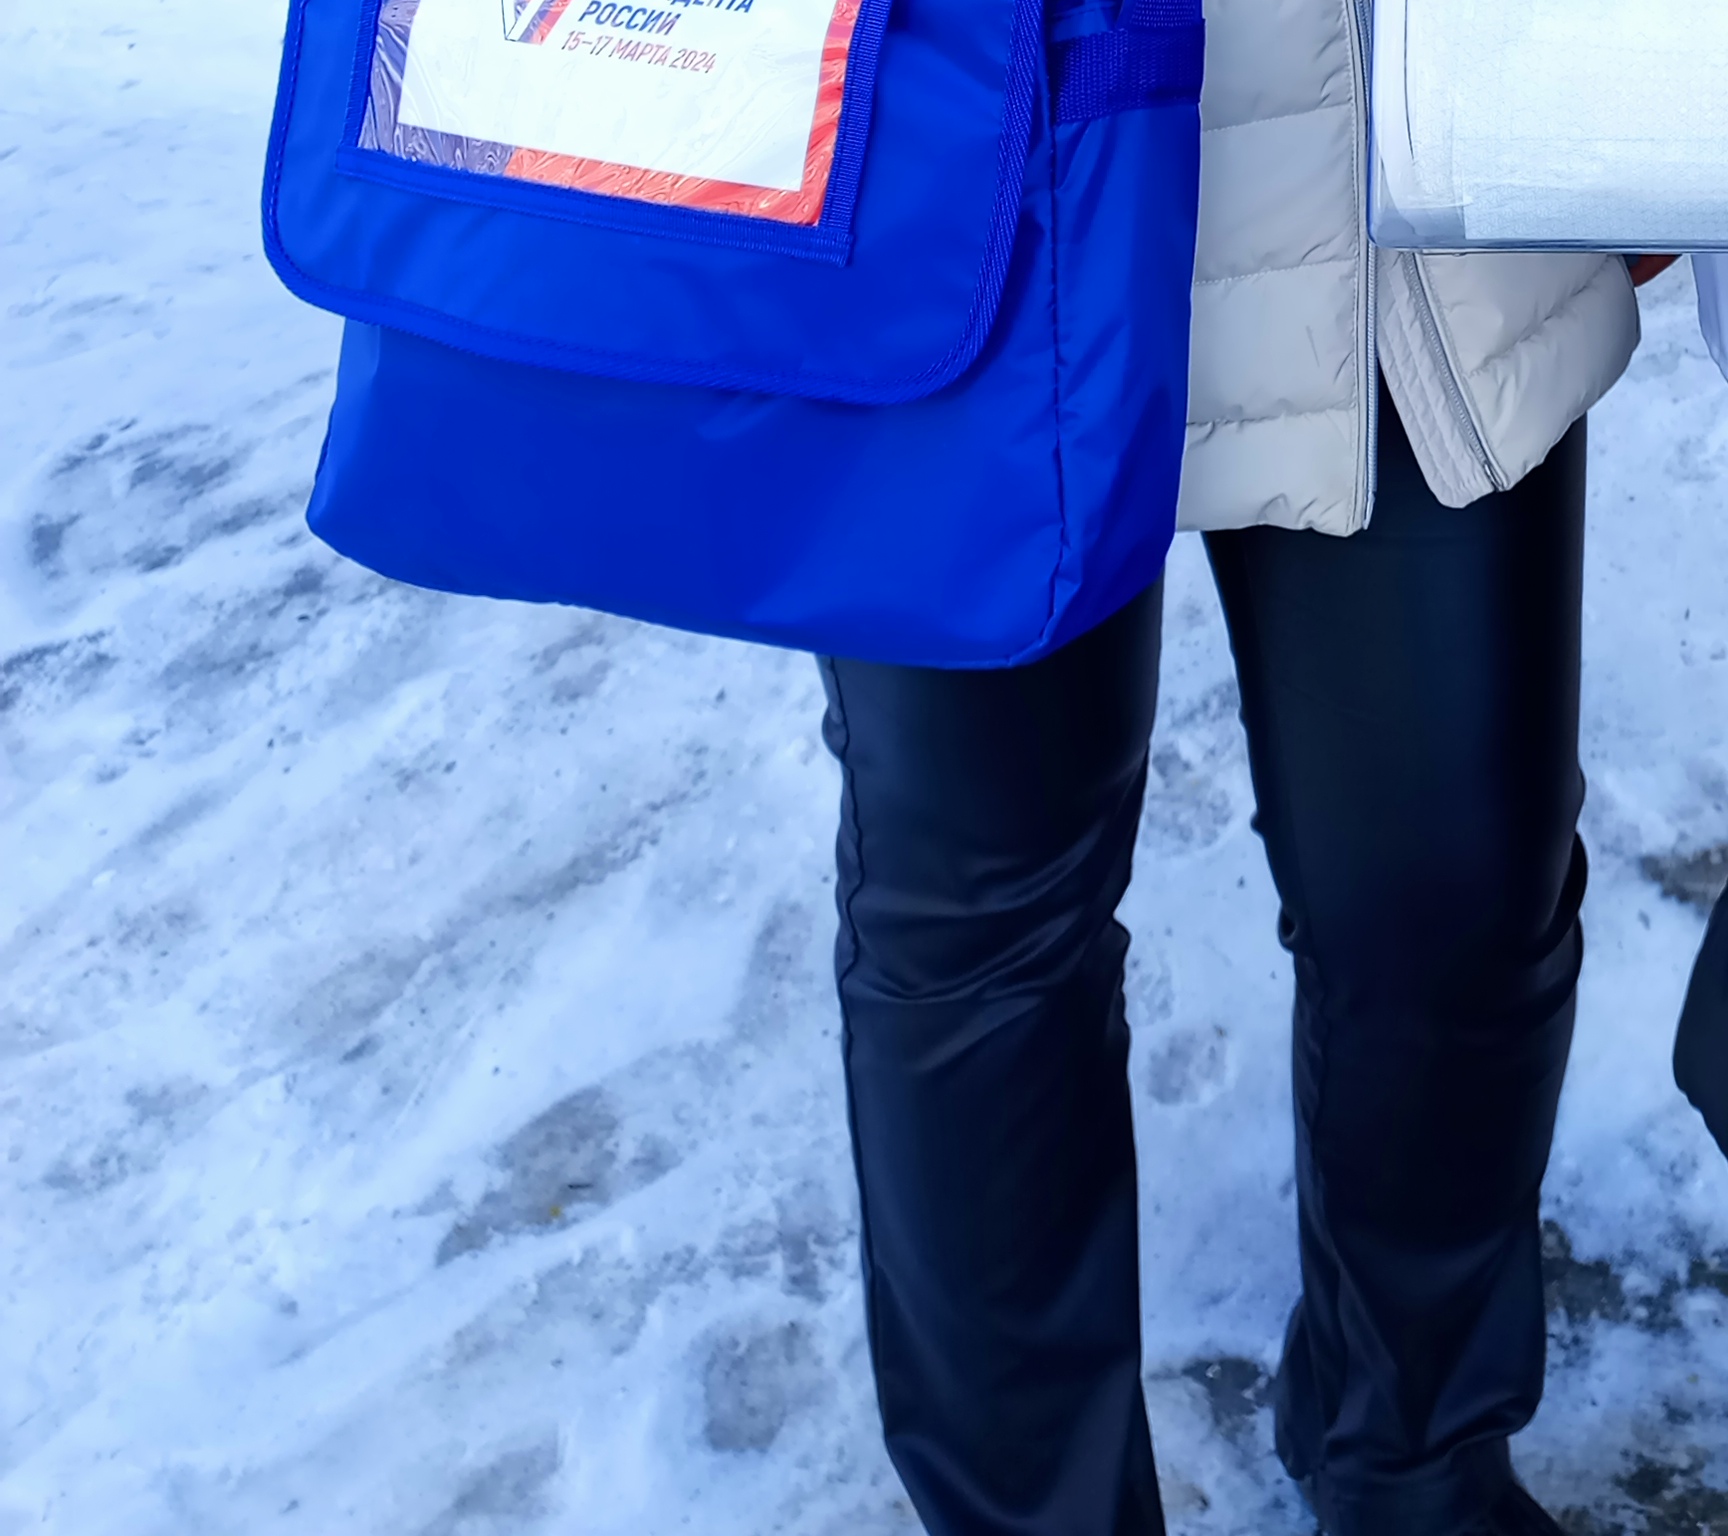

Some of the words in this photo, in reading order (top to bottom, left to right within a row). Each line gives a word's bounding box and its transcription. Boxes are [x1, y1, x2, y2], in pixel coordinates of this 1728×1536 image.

[577, 0, 682, 36] РОССИИ
[608, 38, 672, 66] МАРТА
[669, 48, 717, 74] 2024
